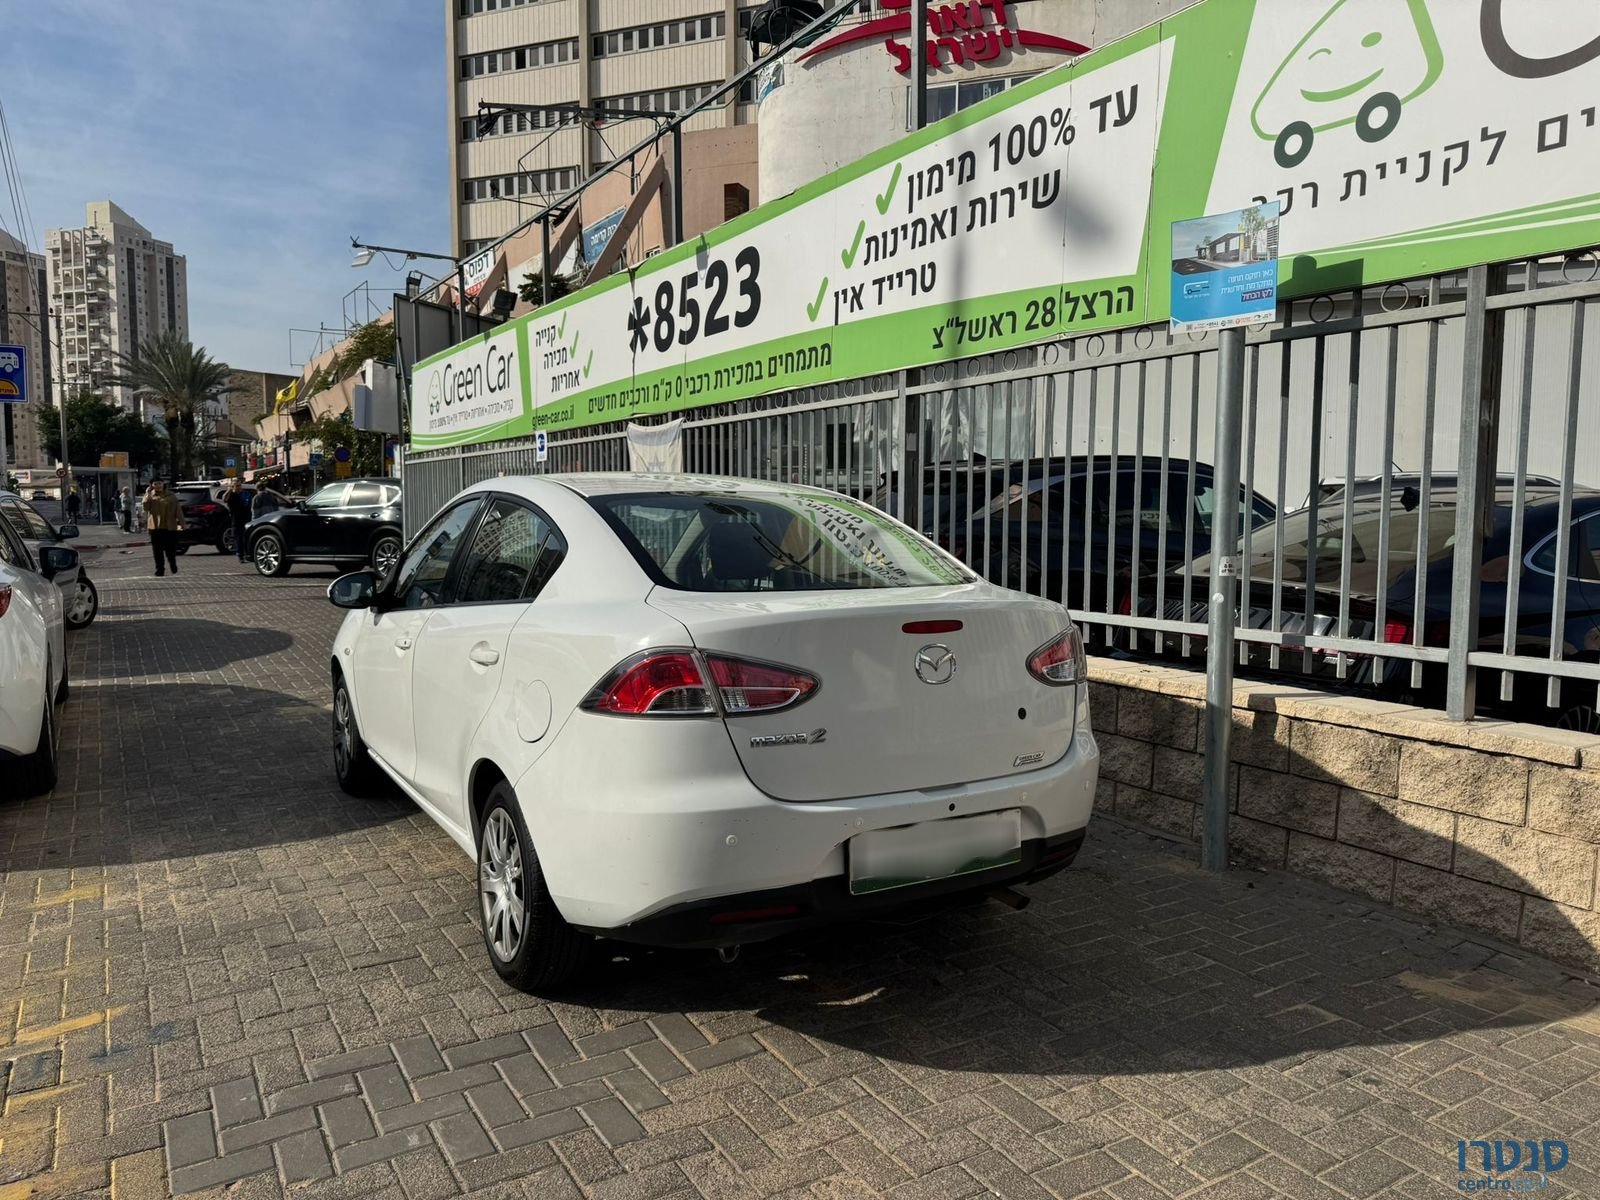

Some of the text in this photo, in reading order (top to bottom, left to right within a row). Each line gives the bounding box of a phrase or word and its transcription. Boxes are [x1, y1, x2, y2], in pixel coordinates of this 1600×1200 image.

[908, 84, 1138, 214] עד 100% מימון
[1339, 126, 1507, 201] לקניית
[1252, 181, 1319, 216] רכ
[863, 169, 1061, 266] שירות ואמינות
[469, 253, 489, 278] דפוס
[834, 261, 937, 326] טרייד אין
[1063, 285, 1134, 323] הרצל
[1024, 296, 1056, 331] 28
[536, 325, 556, 347] קנייה
[543, 347, 567, 369] מכירה
[768, 343, 832, 378] מתמחים
[443, 345, 513, 406] Green Car
[551, 369, 580, 393] אחריות
[675, 375, 683, 397] 0
[685, 373, 710, 396] רכבי
[714, 360, 763, 390] במכירת
[588, 393, 617, 414] חדשים
[619, 383, 650, 408] ורכבים
[532, 404, 575, 430] green-car.co.il
